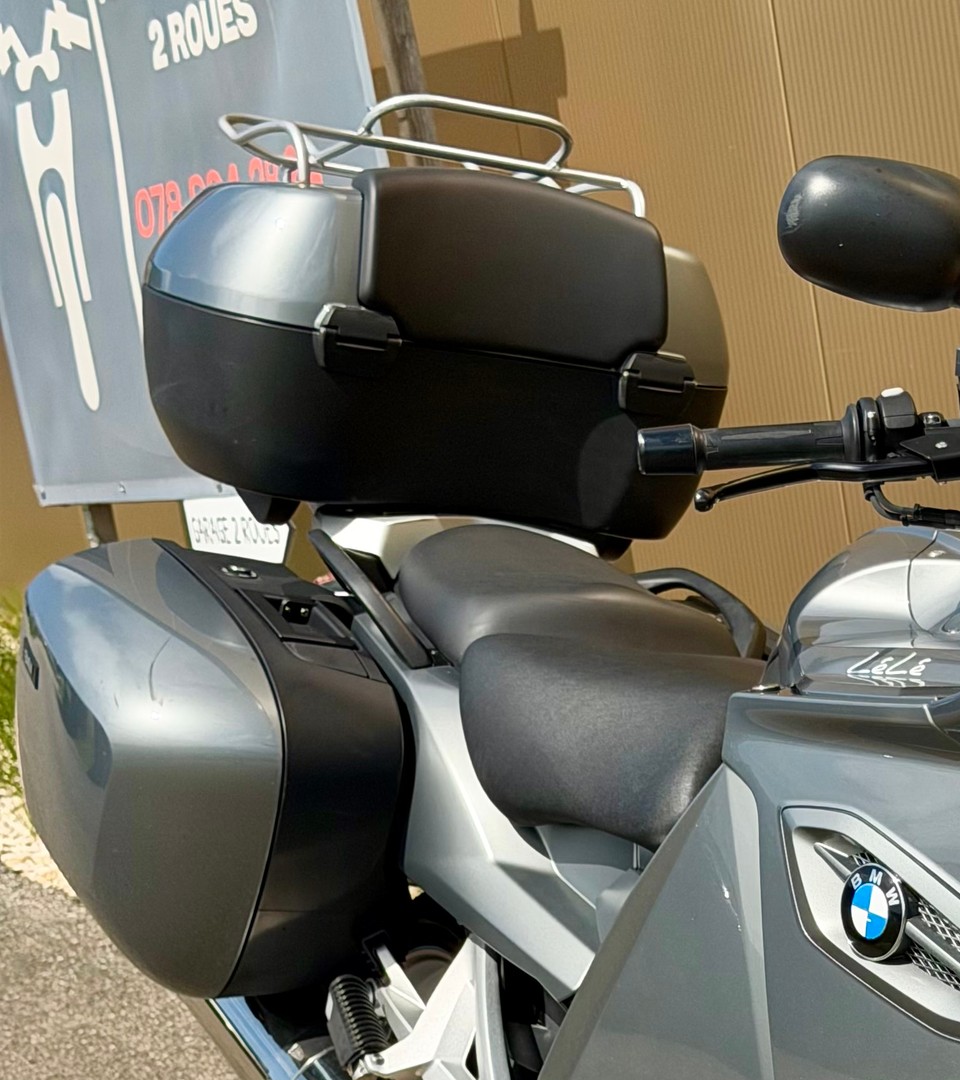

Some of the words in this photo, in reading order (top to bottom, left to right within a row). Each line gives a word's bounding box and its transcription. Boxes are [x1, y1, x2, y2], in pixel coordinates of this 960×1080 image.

[148, 18, 169, 71] 2
[167, 0, 258, 63] ROUES
[191, 516, 232, 545] GARAGE
[230, 516, 243, 545] 2
[850, 868, 900, 906] BMW
